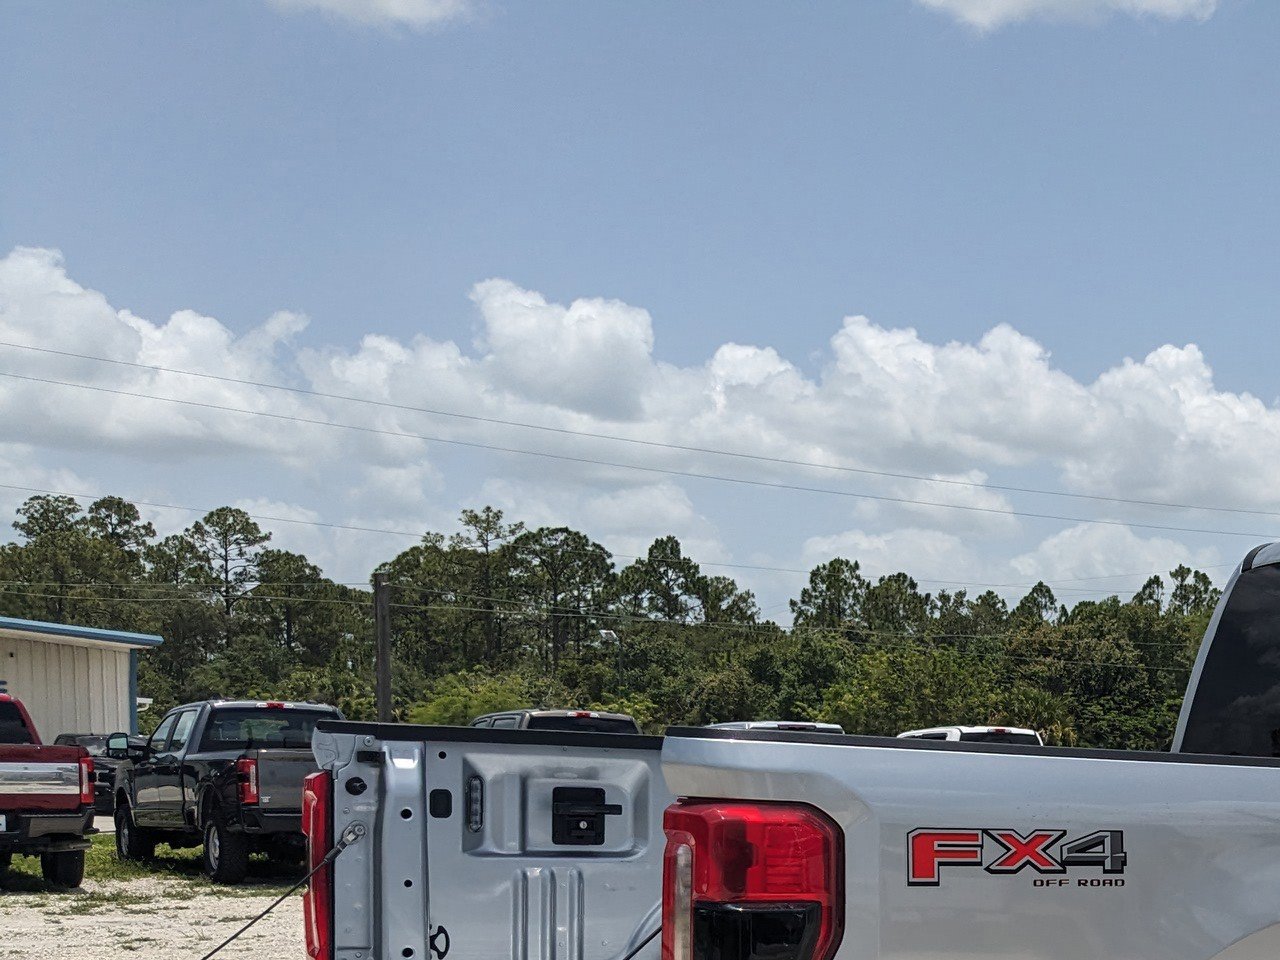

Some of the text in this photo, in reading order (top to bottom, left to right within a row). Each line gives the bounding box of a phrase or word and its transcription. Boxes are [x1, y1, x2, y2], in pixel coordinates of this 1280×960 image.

[907, 827, 1127, 887] FX4
[1033, 878, 1125, 887] OFF ROAD
